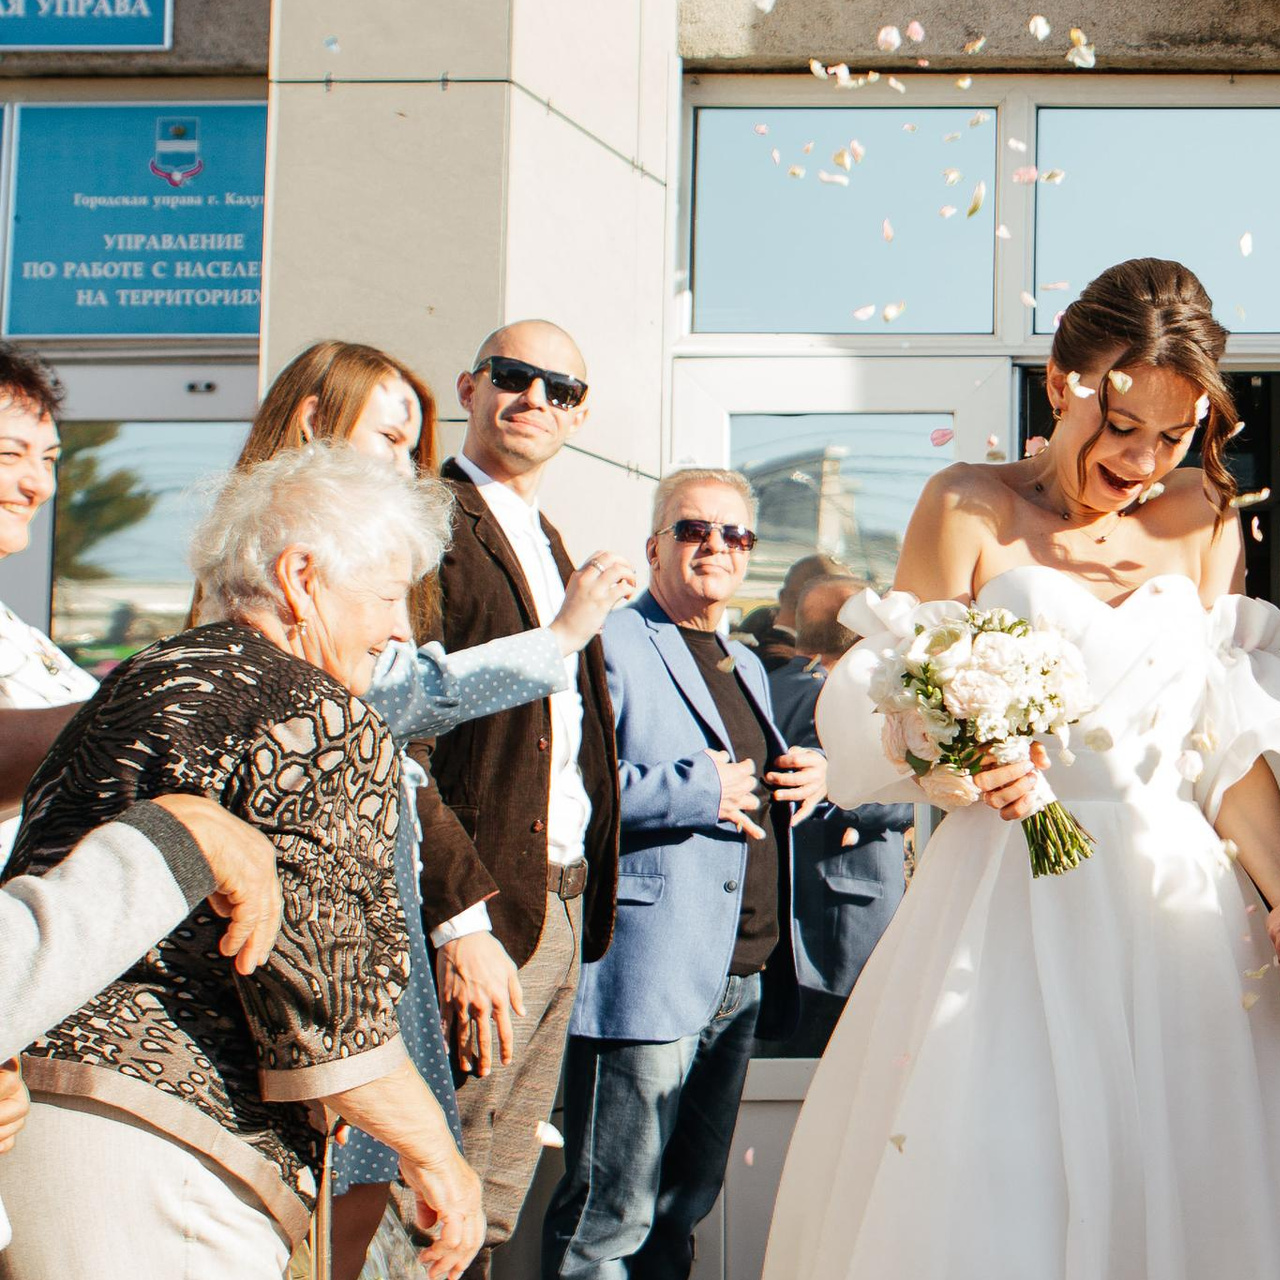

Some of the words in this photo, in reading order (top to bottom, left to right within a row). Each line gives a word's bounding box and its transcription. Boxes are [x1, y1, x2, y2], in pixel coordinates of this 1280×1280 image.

[74, 193, 148, 209] Городская
[153, 195, 203, 209] управа
[103, 233, 245, 251] УПРАВЛЕНИЕ
[22, 261, 56, 279] ПО
[63, 261, 144, 279] РАБОТЕ
[152, 261, 167, 279] С
[174, 261, 263, 279] НАСЕЛЕ
[76, 289, 108, 307] НА
